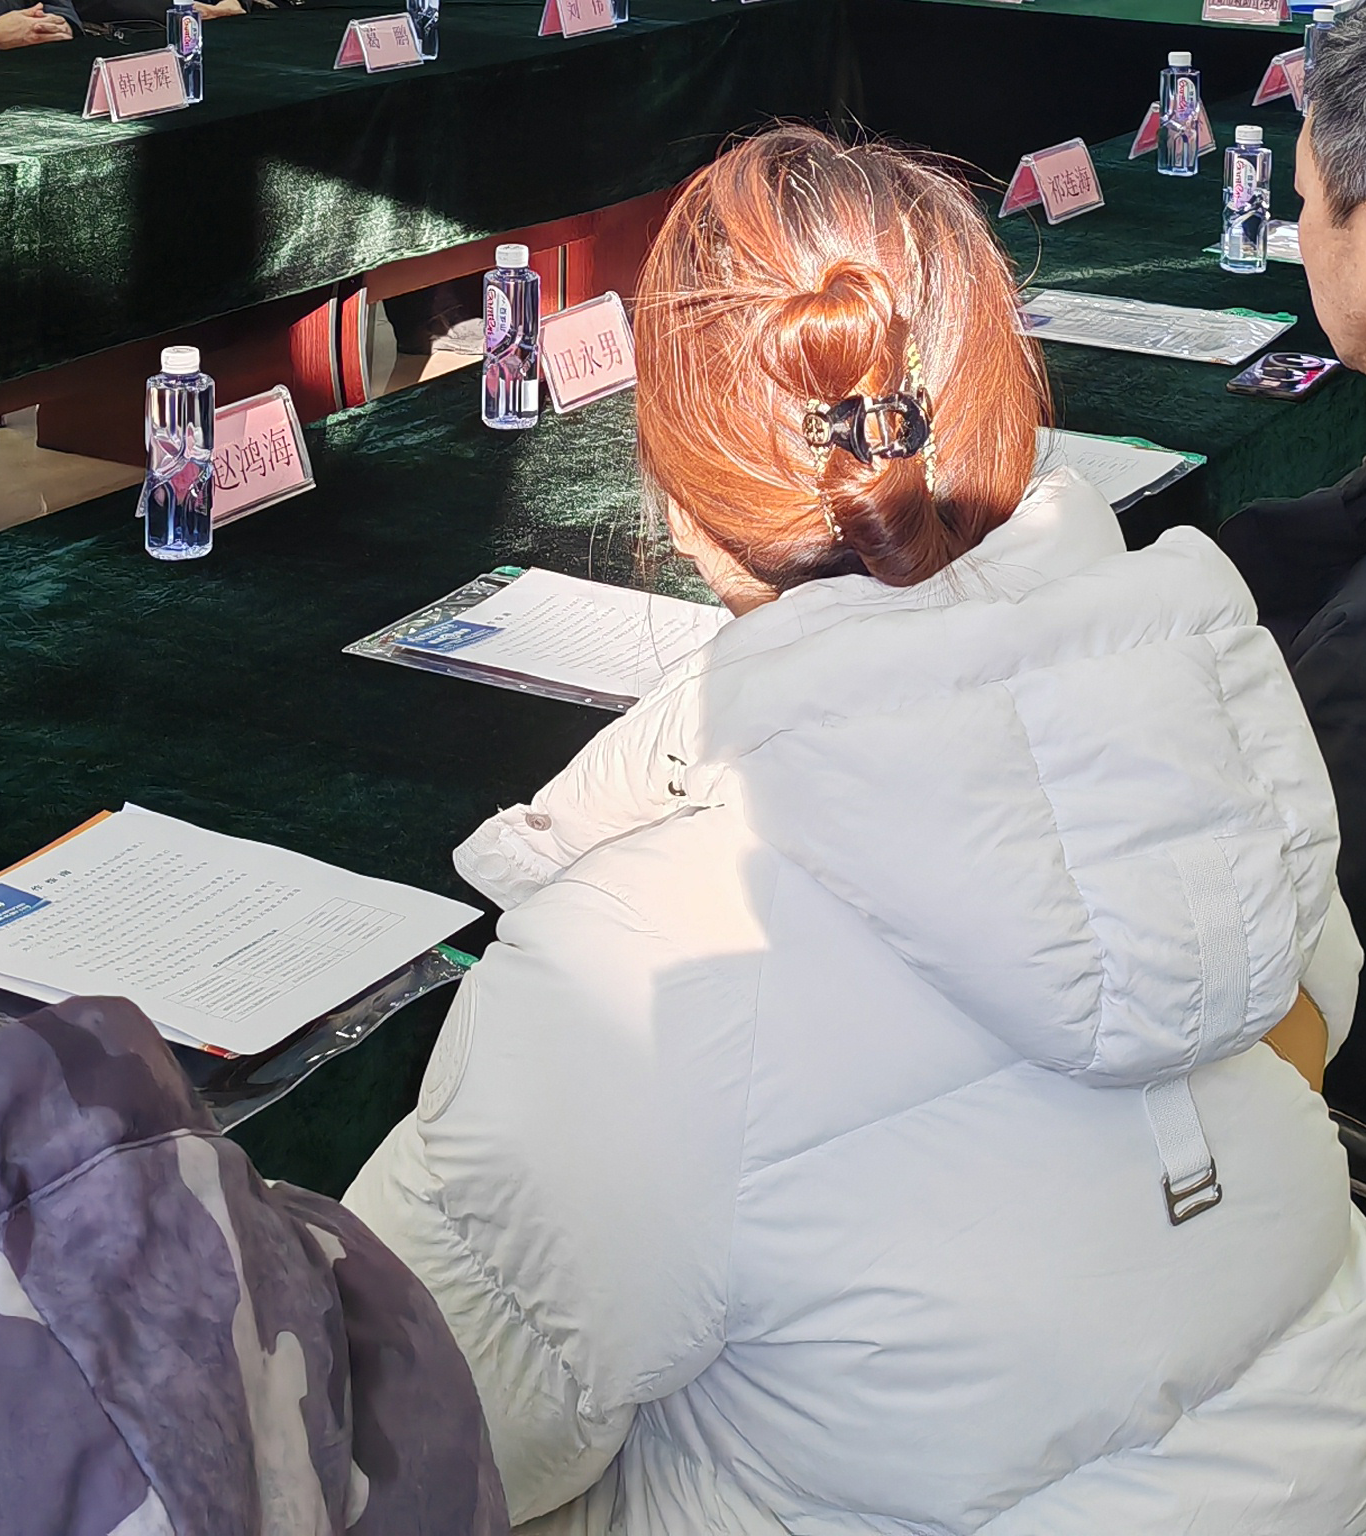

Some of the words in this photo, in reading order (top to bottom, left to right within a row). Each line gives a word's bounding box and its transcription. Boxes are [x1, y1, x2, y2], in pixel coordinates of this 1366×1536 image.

[118, 66, 172, 98] 韩传辉
[1047, 166, 1090, 204] 祁连海
[213, 428, 294, 491] 赵鸿海
